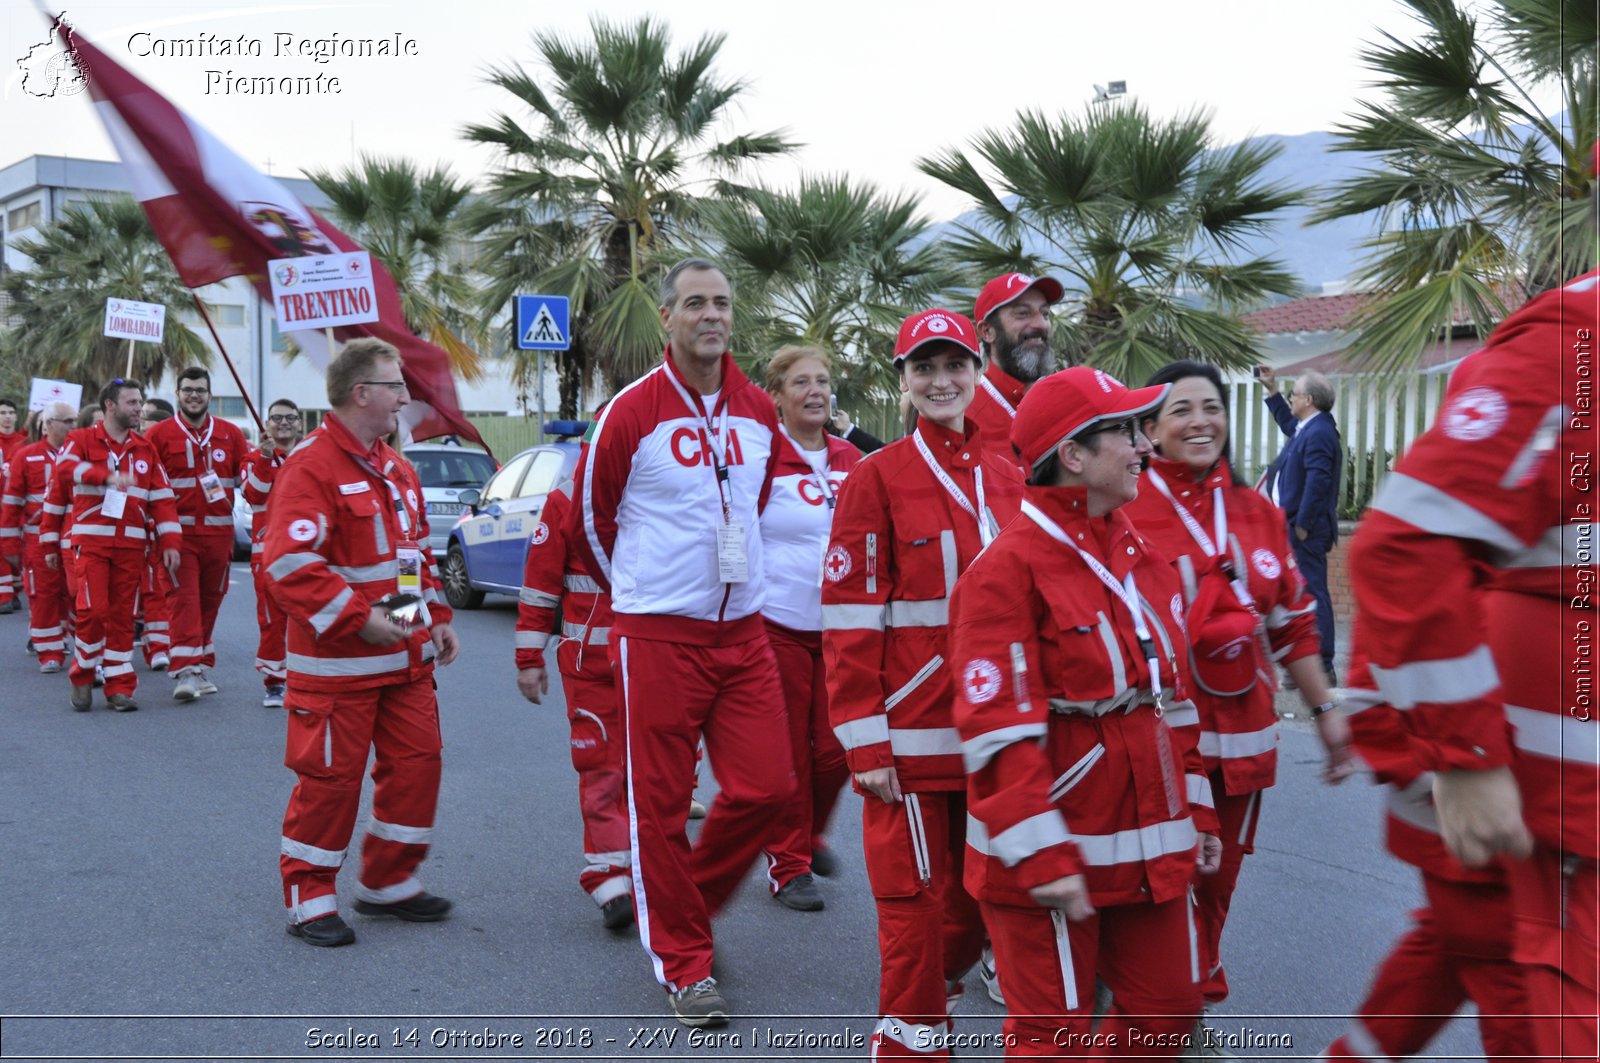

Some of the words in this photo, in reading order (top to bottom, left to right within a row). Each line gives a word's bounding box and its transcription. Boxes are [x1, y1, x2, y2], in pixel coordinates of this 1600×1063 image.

[279, 286, 371, 322] TRENTINO
[108, 315, 160, 337] LOMBARDIA
[670, 427, 744, 467] CRI
